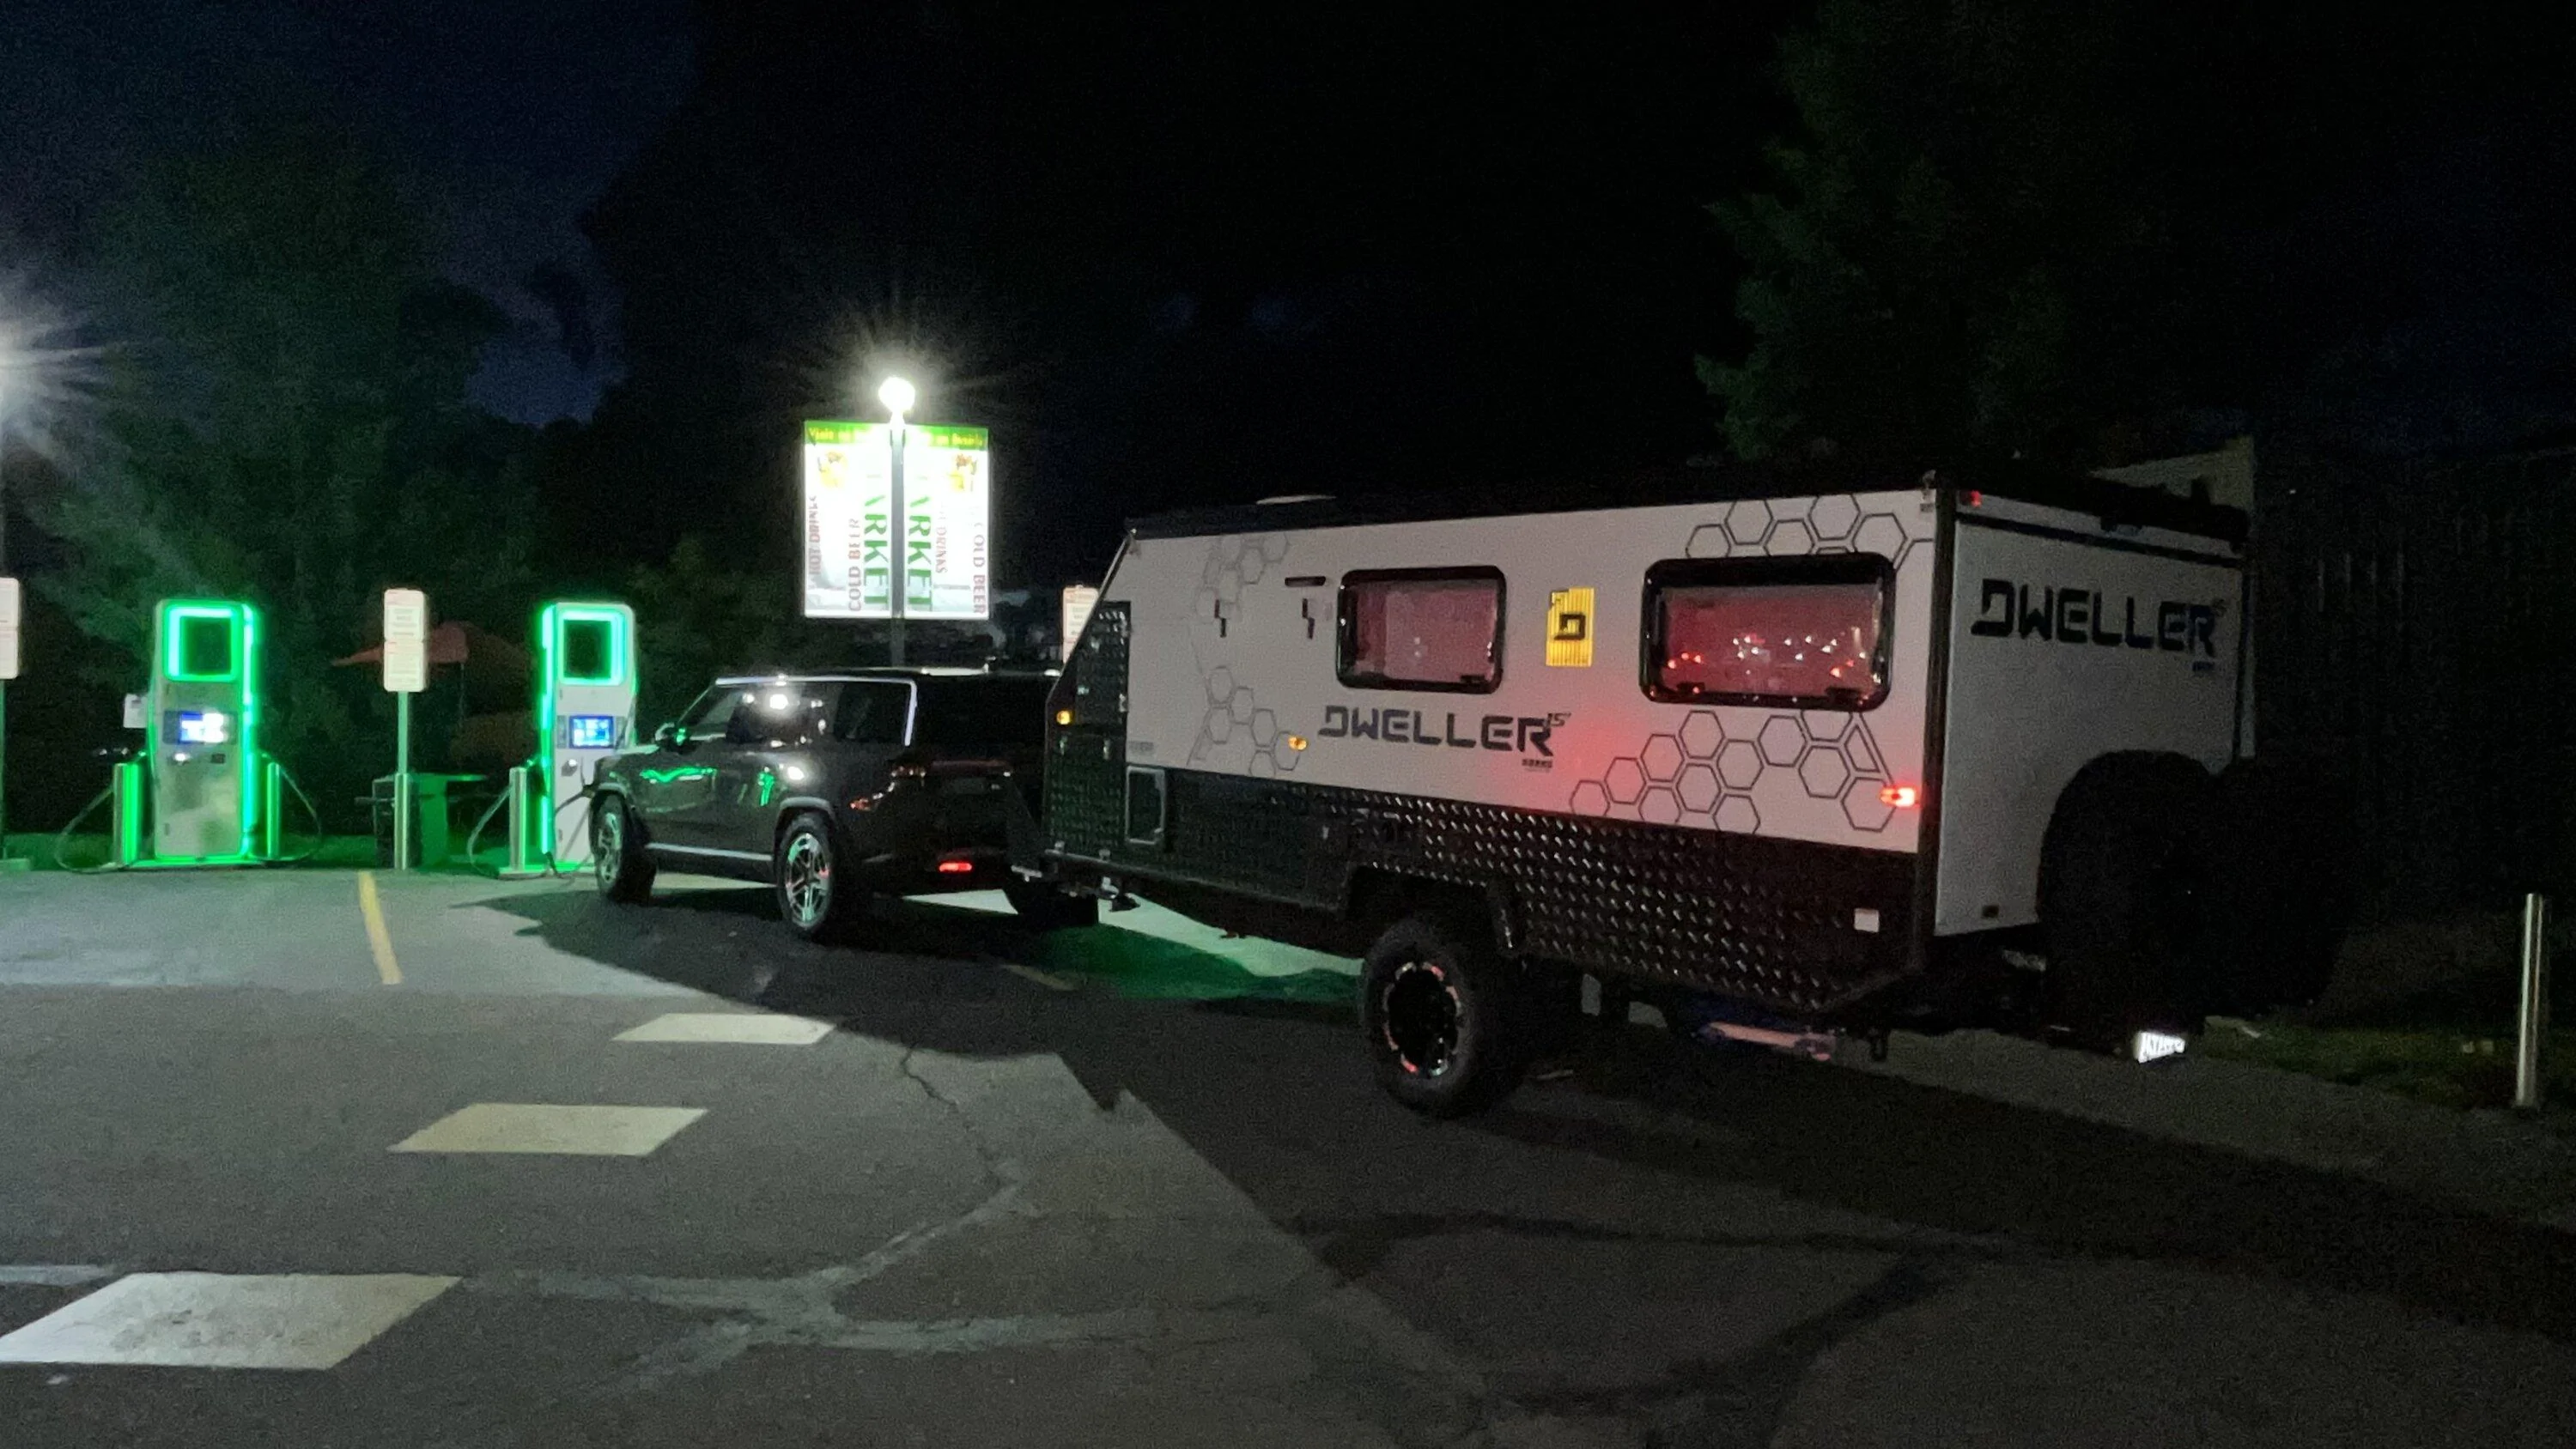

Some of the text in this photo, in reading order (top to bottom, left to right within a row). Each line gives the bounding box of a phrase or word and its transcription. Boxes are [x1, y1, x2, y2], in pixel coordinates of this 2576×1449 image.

[848, 518, 861, 612] COLD BEER
[973, 574, 986, 614] BEER
[1970, 579, 2217, 658] DWELLER
[1317, 704, 1554, 757] DWELLER
